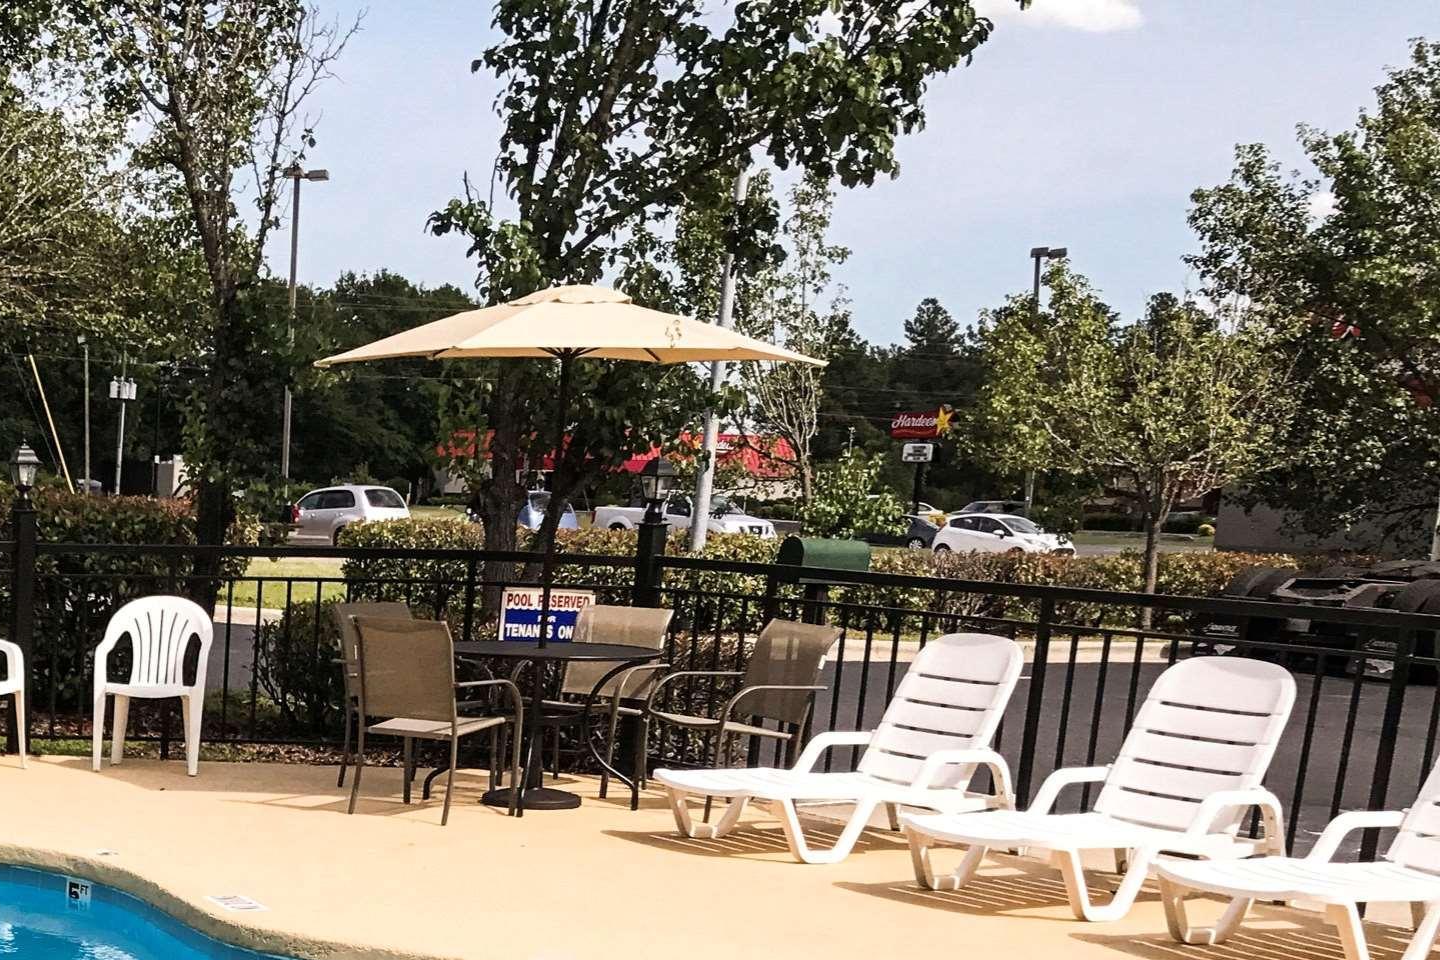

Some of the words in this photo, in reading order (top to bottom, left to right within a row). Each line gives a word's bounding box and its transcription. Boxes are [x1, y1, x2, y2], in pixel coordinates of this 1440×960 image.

[506, 593, 533, 608] POOL
[538, 594, 590, 609] RSERVED
[505, 623, 553, 639] TENANS
